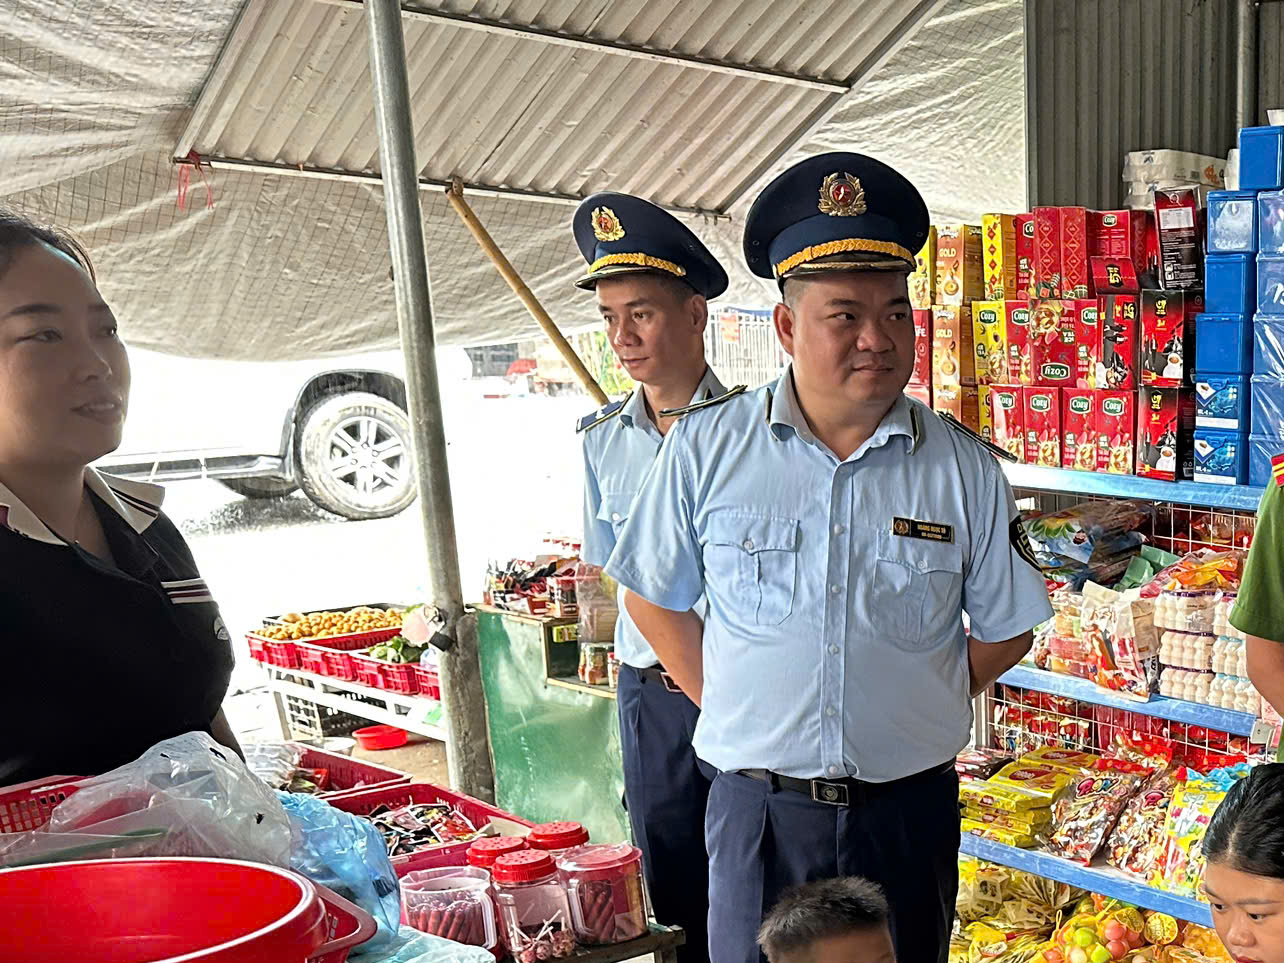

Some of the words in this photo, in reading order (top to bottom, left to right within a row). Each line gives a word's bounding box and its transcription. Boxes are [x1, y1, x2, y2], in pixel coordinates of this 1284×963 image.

[980, 312, 995, 322] Cozy
[1014, 312, 1029, 322] Cozy
[1045, 366, 1067, 376] Cozy
[1032, 397, 1048, 408] Cozy
[1072, 399, 1090, 411] Cozy
[1105, 401, 1122, 412] Cozy
